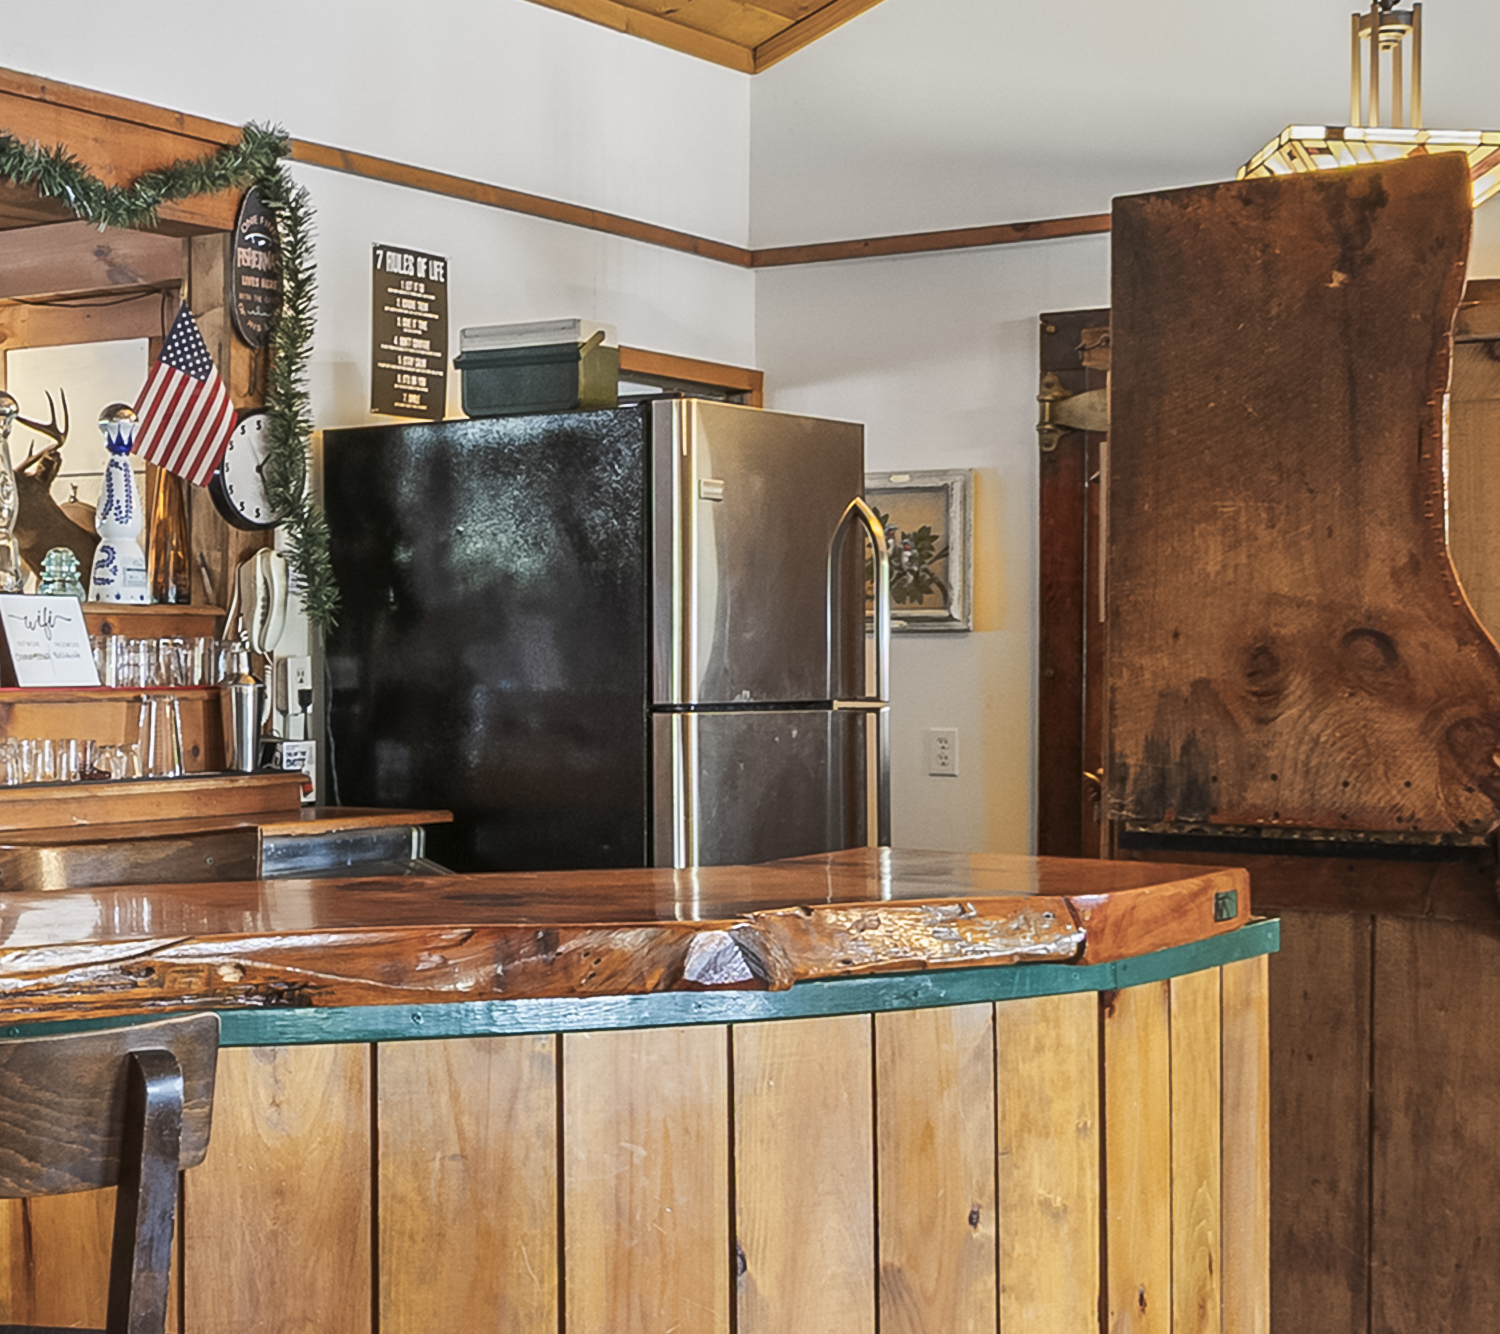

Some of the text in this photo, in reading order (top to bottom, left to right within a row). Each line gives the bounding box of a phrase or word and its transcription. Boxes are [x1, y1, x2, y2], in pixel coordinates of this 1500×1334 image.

[376, 249, 445, 283] 7 RULES OF LIFE
[8, 607, 72, 641] wifi
